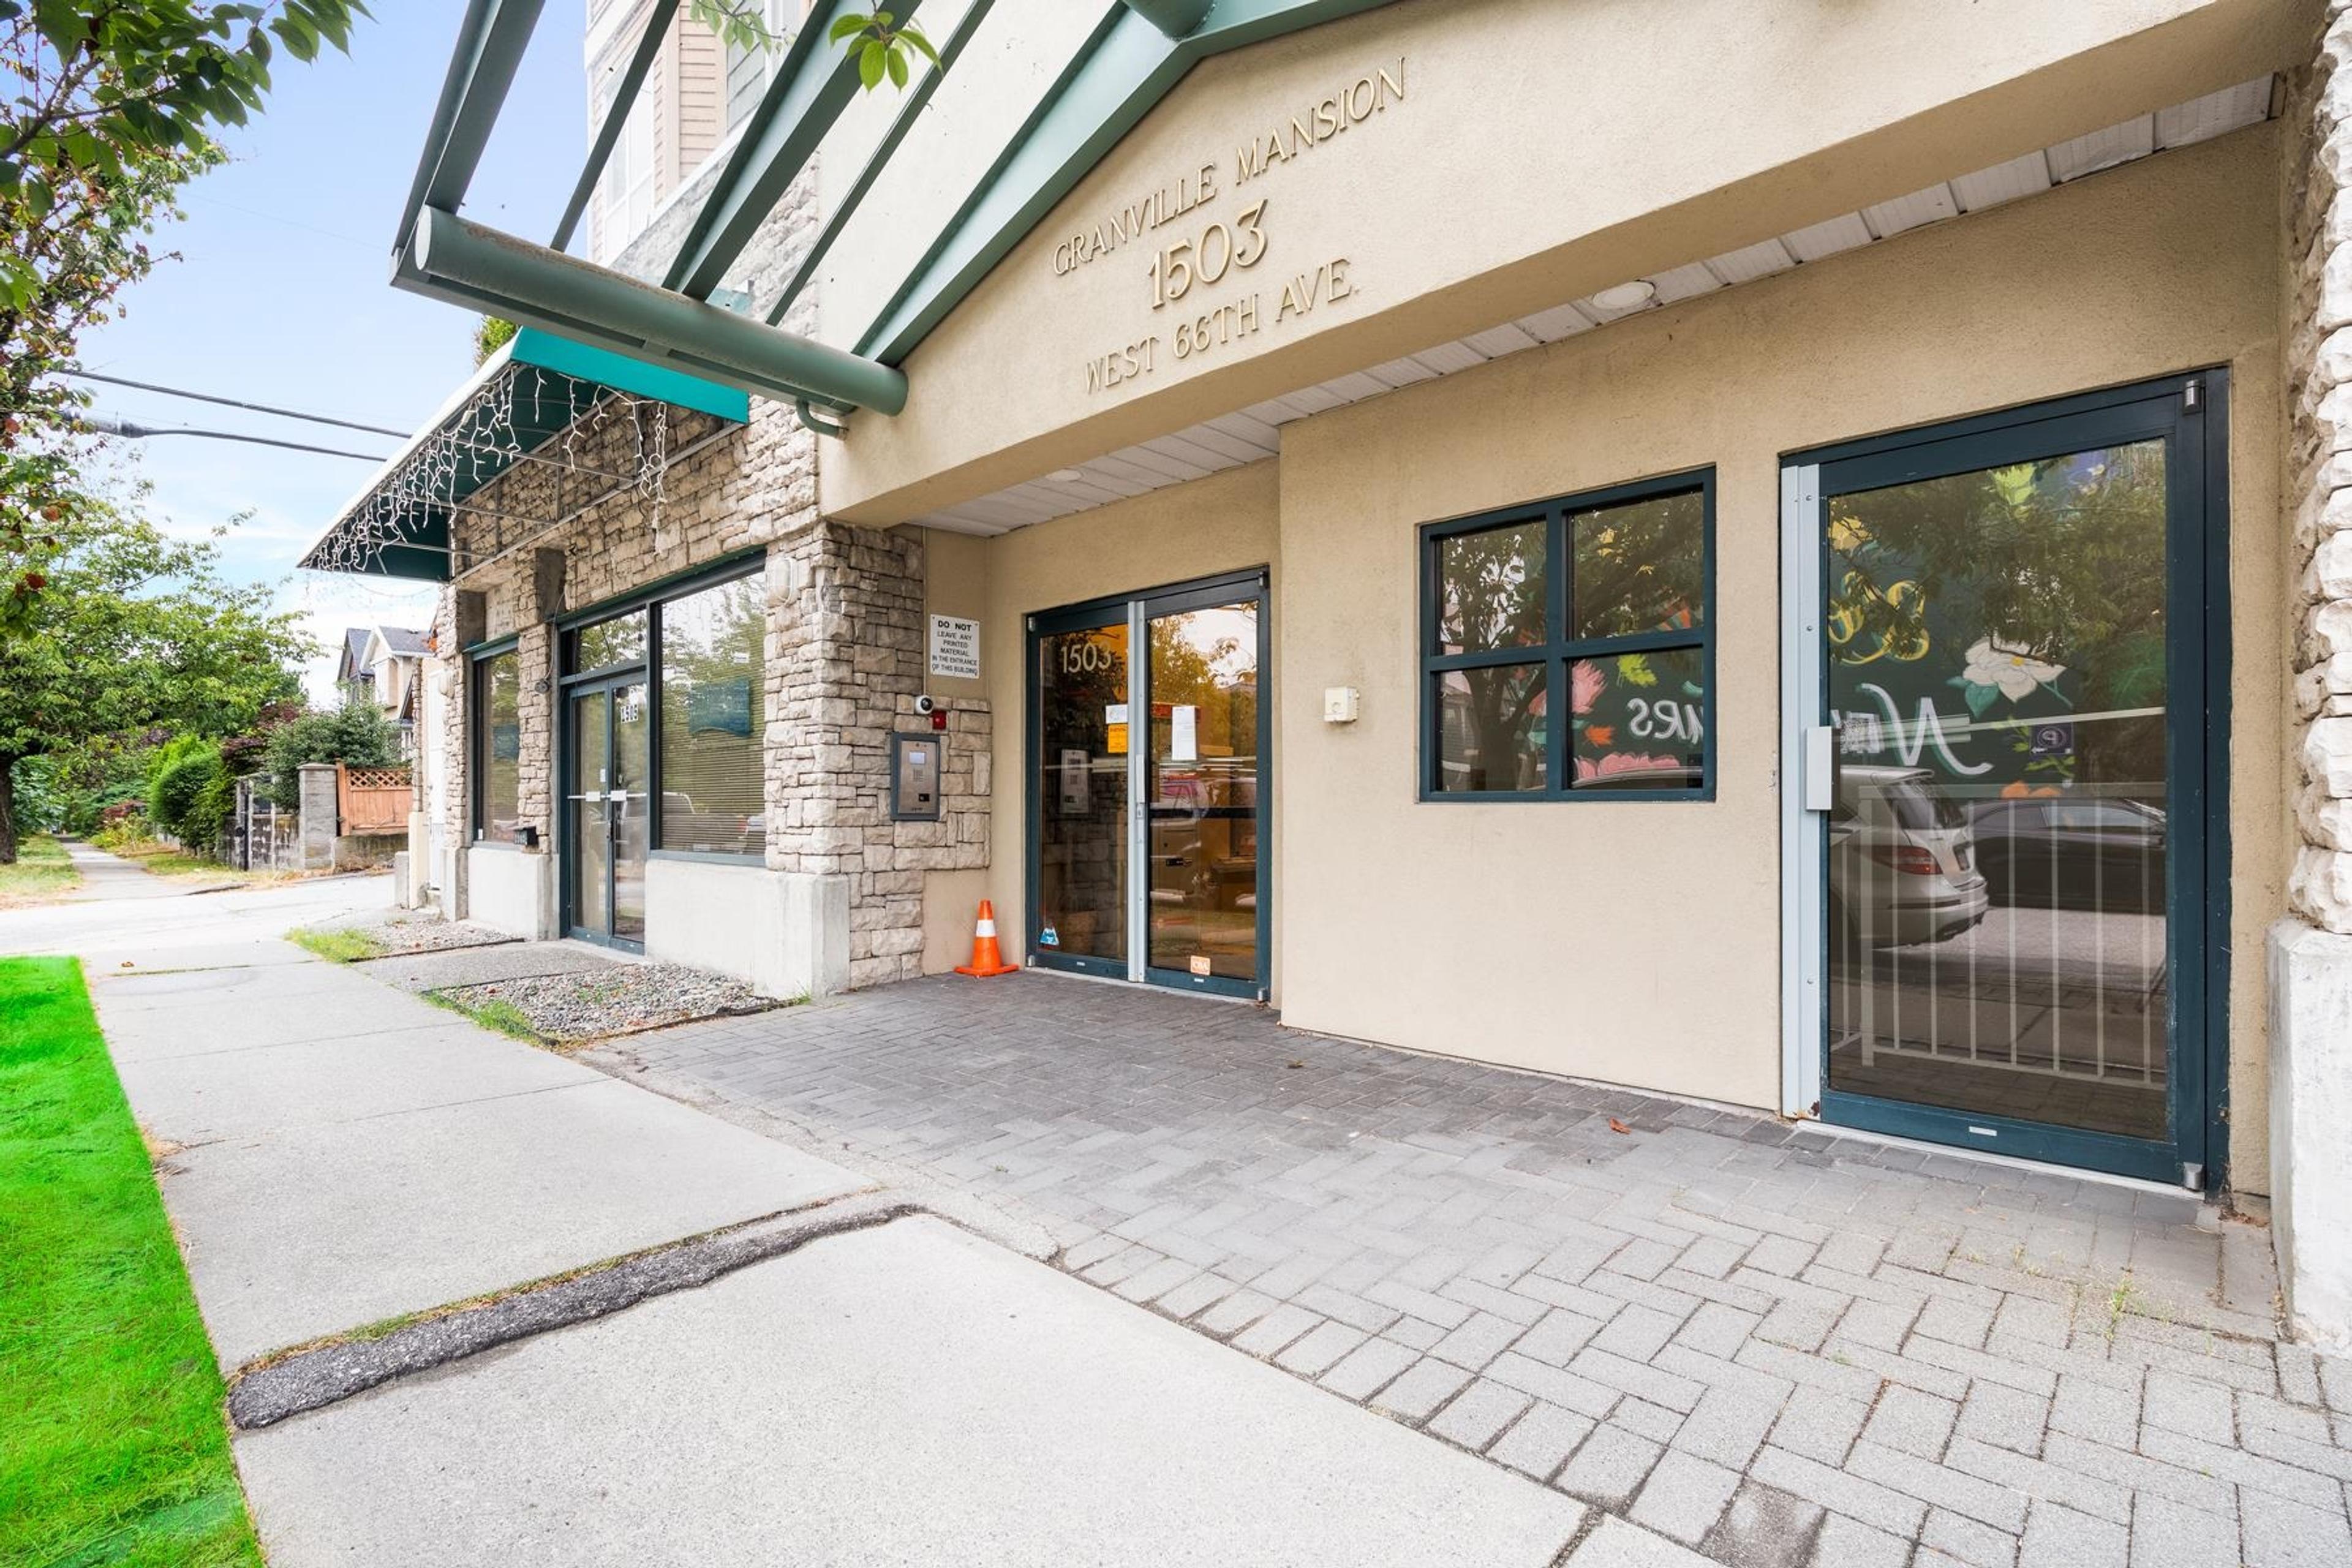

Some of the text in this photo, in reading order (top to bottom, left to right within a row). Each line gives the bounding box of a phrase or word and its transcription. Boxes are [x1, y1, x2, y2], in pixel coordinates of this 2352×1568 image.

[1054, 57, 1405, 276] GRANVILLE MANSION
[1147, 198, 1269, 309] 1503
[1084, 258, 1360, 394] WEST 66TH AVE.
[938, 620, 971, 631] DO NOT
[937, 631, 956, 639] LEAVE
[943, 639, 969, 649] PRINTED
[940, 647, 970, 657] MATERIAL
[1061, 641, 1111, 673] 1503
[950, 657, 977, 666] ENTRANCE
